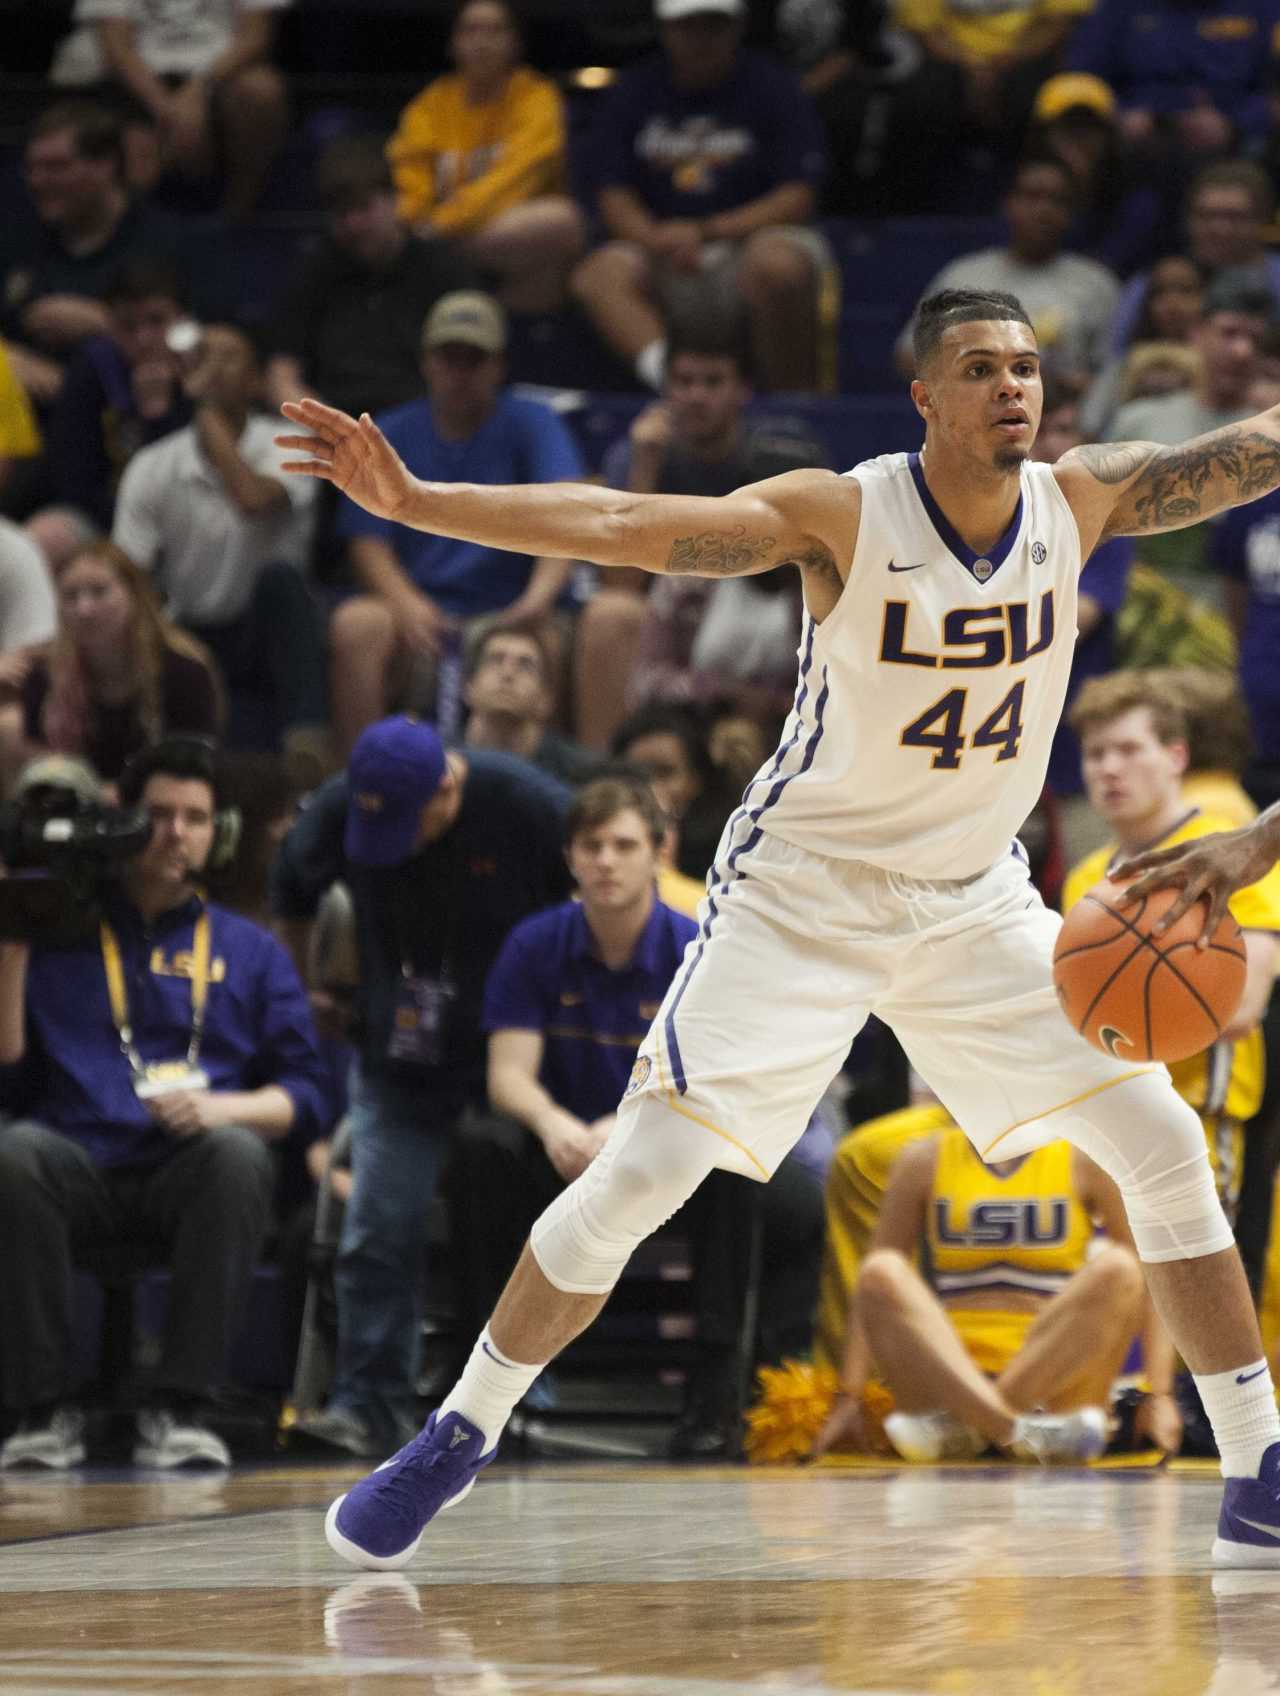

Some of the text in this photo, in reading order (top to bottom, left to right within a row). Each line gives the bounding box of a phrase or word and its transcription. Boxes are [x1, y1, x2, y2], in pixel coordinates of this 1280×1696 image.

[878, 587, 1055, 669] LSU
[899, 678, 1027, 770] 44
[933, 1197, 1069, 1249] LSU
